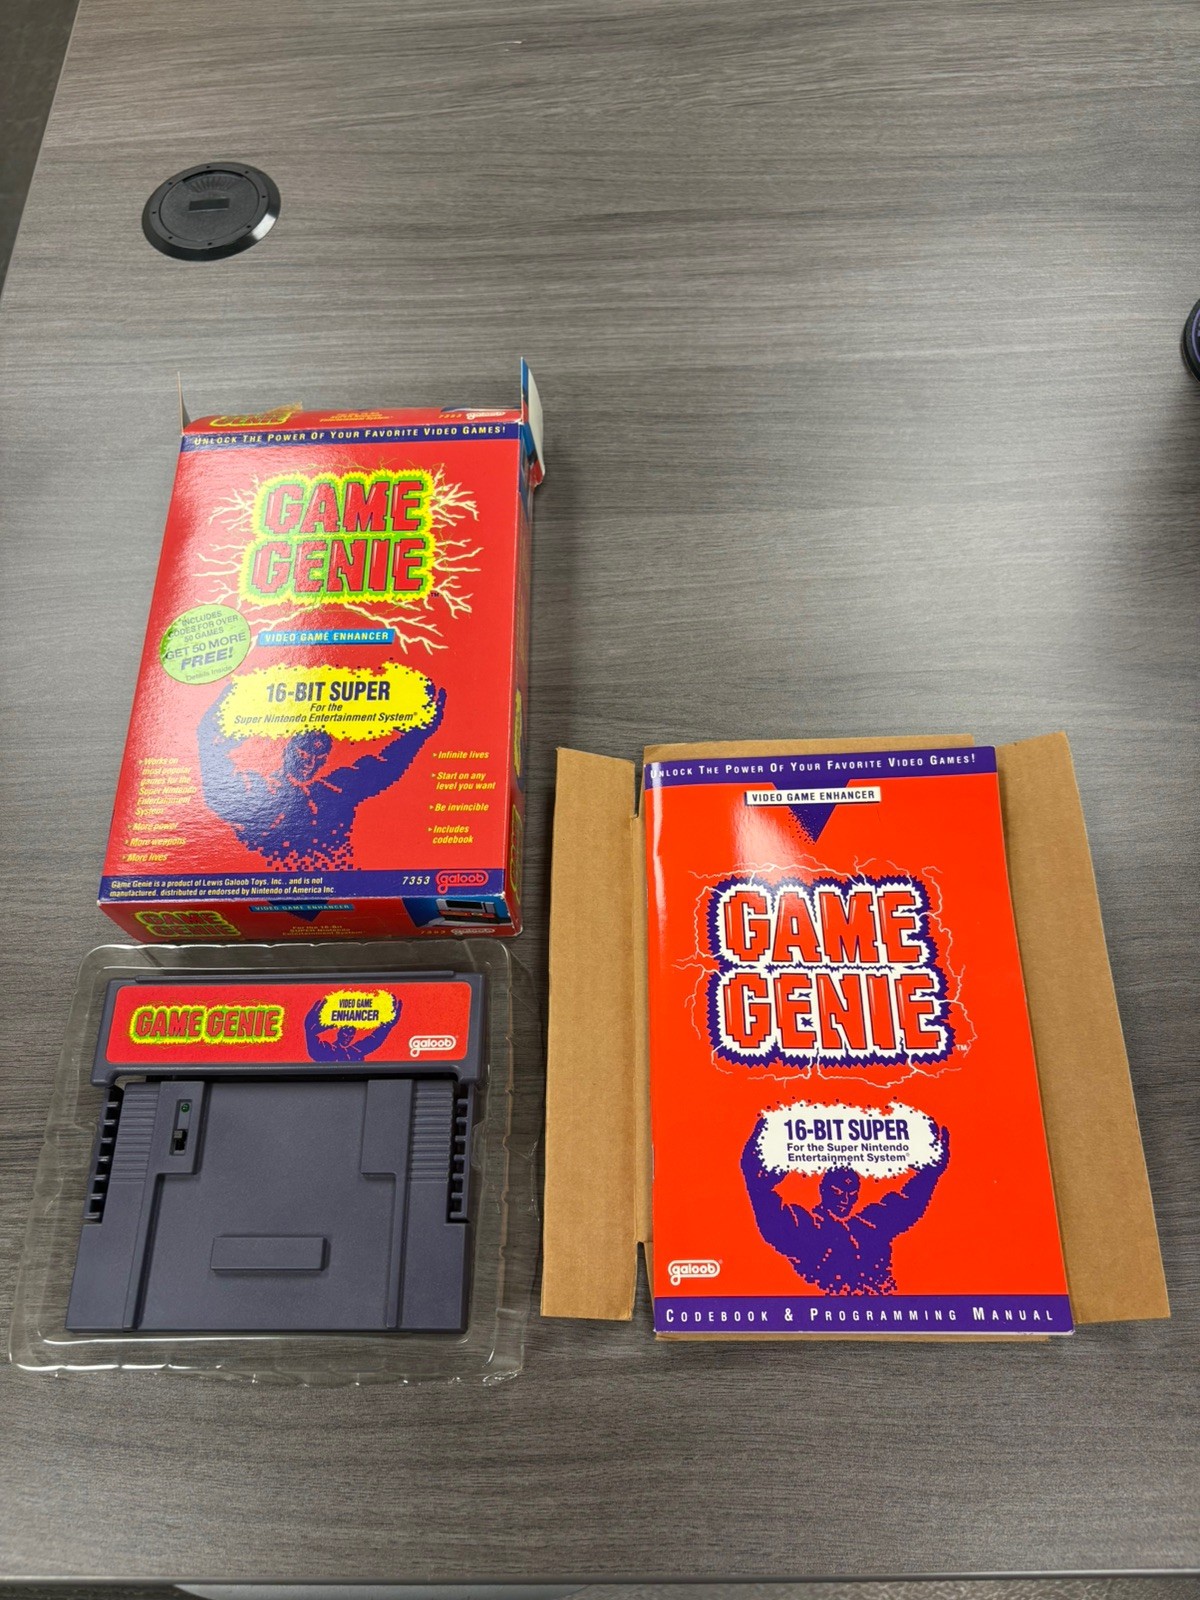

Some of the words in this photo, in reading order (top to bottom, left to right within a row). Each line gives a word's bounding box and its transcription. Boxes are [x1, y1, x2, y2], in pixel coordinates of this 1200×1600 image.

[194, 436, 238, 446] UNLOCK
[243, 434, 262, 442] THE
[268, 434, 306, 442] POWER
[365, 429, 418, 438] FAVORITE
[424, 427, 458, 436] VIDEO
[462, 426, 506, 434] GAMES!
[264, 481, 425, 534] GAME
[251, 537, 425, 594] GENIE
[168, 624, 198, 638] CODES
[198, 620, 216, 632] FOR
[216, 614, 238, 627] OVER
[182, 610, 222, 626] INCLUDES
[184, 633, 194, 643] 50
[195, 627, 224, 641] GAMES
[265, 633, 296, 642] VIDEO
[300, 632, 329, 642] GAME
[333, 631, 389, 641] ENHANCER
[166, 646, 191, 661] GET
[192, 640, 206, 652] 50
[208, 632, 247, 650] MORE
[180, 647, 234, 671] FREE!
[185, 670, 210, 682] Details
[210, 665, 232, 677] Inside
[266, 682, 326, 702] 16-BIT
[329, 680, 390, 702] SUPER
[310, 703, 325, 712] For
[328, 703, 343, 712] the
[234, 715, 262, 725] Super
[264, 714, 306, 723] Nintendo
[308, 712, 376, 722] Entertainment
[650, 768, 693, 779] UNLOCK
[698, 765, 719, 774] THE
[726, 764, 764, 774] POWER
[770, 762, 784, 772] OF
[790, 761, 821, 772] YOUR
[827, 760, 882, 770] FAVORITE
[888, 757, 924, 768] VIDEO
[930, 754, 976, 766] GAMES!
[752, 792, 782, 802] VIDEO
[787, 792, 816, 802] GAME
[820, 790, 875, 800] ENHANCER
[448, 803, 489, 811] invincible
[434, 825, 470, 833] Includes
[130, 838, 150, 846] More
[151, 838, 186, 847] weapons
[432, 836, 474, 844] codebook
[127, 854, 147, 862] More
[148, 853, 168, 862] lives
[167, 879, 194, 888] product
[195, 878, 202, 886] of
[202, 878, 223, 886] Lewis
[224, 878, 249, 886] Galoob
[402, 876, 430, 885] 7353
[436, 870, 488, 894] galoob
[160, 888, 198, 896] distributed
[208, 888, 240, 896] endorsed
[241, 888, 250, 897] by
[143, 912, 224, 924] GAME
[151, 925, 238, 936] GENIE
[724, 891, 922, 963] GAME
[338, 998, 356, 1008] VIDEO
[356, 998, 372, 1008] GAME
[330, 1010, 379, 1022] ENHANCER
[724, 973, 941, 1050] GENIE
[135, 1008, 202, 1038] GAME
[206, 1009, 281, 1038] GENIE
[409, 1036, 456, 1058] galoob
[784, 1119, 844, 1141] 16-BIT
[848, 1119, 910, 1141] SUPER
[786, 1143, 805, 1152] For
[807, 1143, 824, 1152] the
[827, 1143, 858, 1153] Super
[862, 1142, 909, 1152] Nintendo
[788, 1153, 864, 1162] Entertainment
[668, 1260, 720, 1286] galoob
[666, 1308, 769, 1322] CODEBOOK
[784, 1308, 794, 1322] &
[810, 1308, 958, 1322] PROGRAMMING
[972, 1306, 1054, 1321] MANUAL
